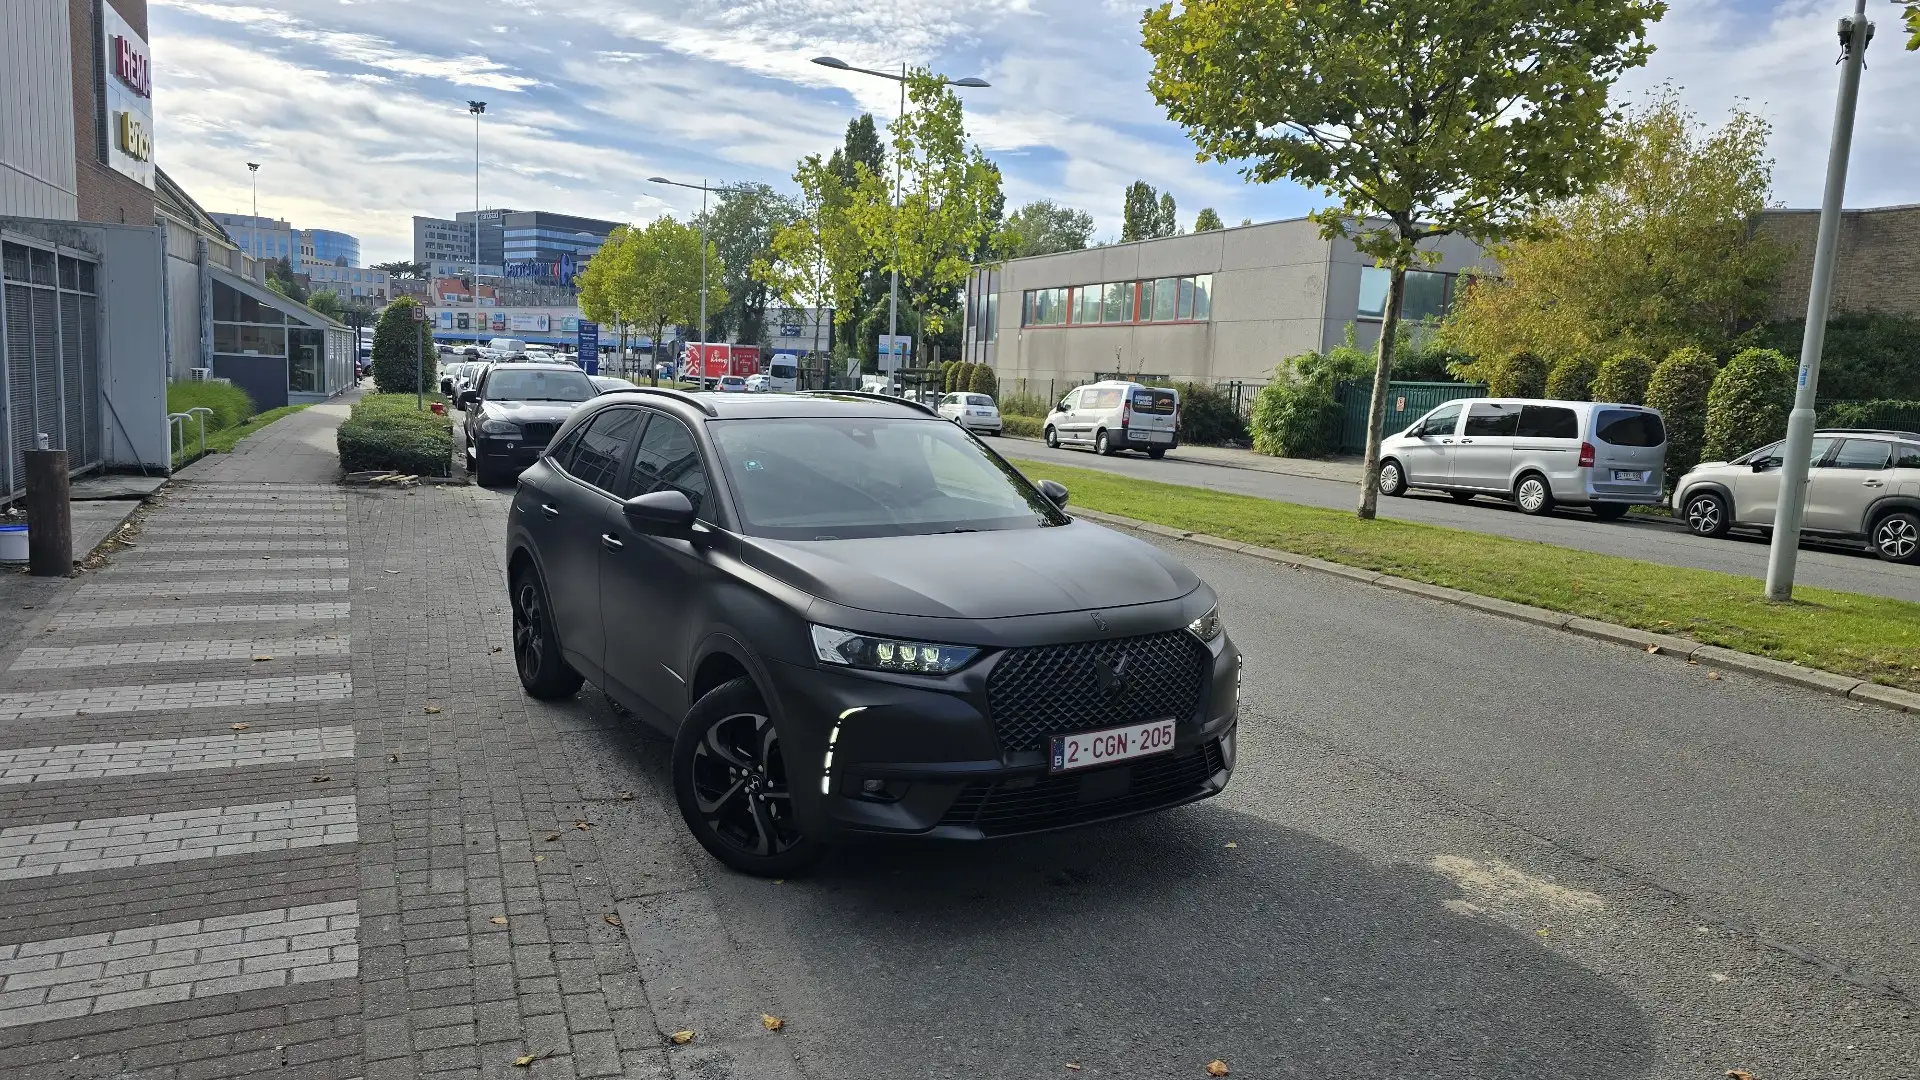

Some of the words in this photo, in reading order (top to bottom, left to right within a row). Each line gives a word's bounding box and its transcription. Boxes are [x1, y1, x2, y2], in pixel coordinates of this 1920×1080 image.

[115, 35, 151, 99] HEMA
[480, 209, 499, 220] randstad
[416, 307, 423, 318] B
[1068, 725, 1173, 763] 2-CGN-205
[1054, 755, 1063, 766] B
